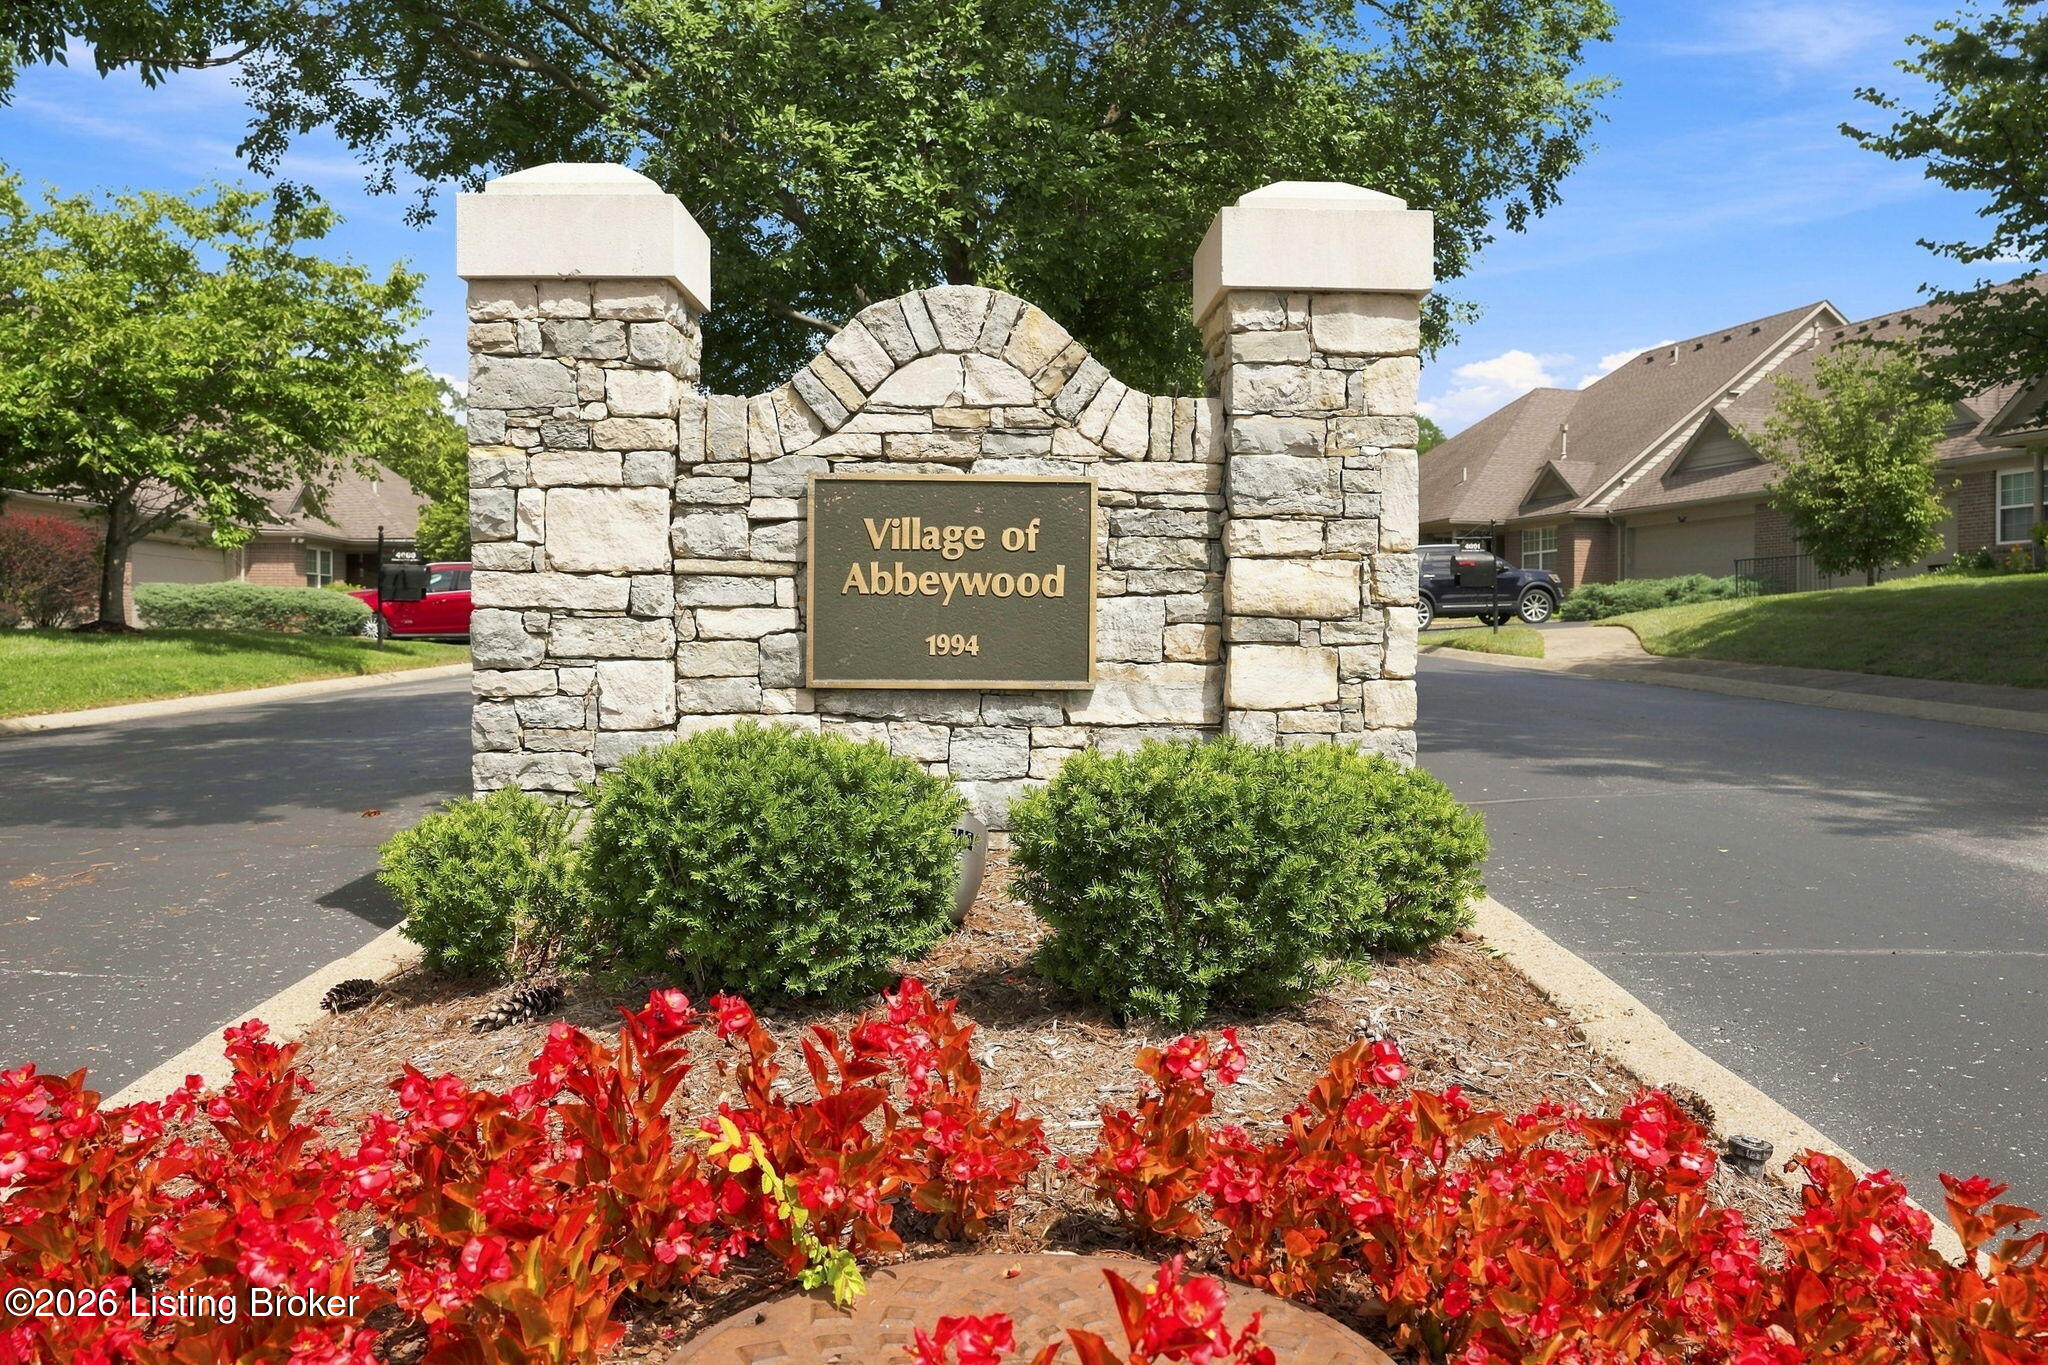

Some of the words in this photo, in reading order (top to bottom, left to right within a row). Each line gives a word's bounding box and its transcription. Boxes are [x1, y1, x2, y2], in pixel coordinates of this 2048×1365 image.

[863, 516, 986, 561] Village
[1001, 517, 1041, 552] of
[841, 560, 1066, 606] Abbeywood
[925, 633, 980, 657] 1994
